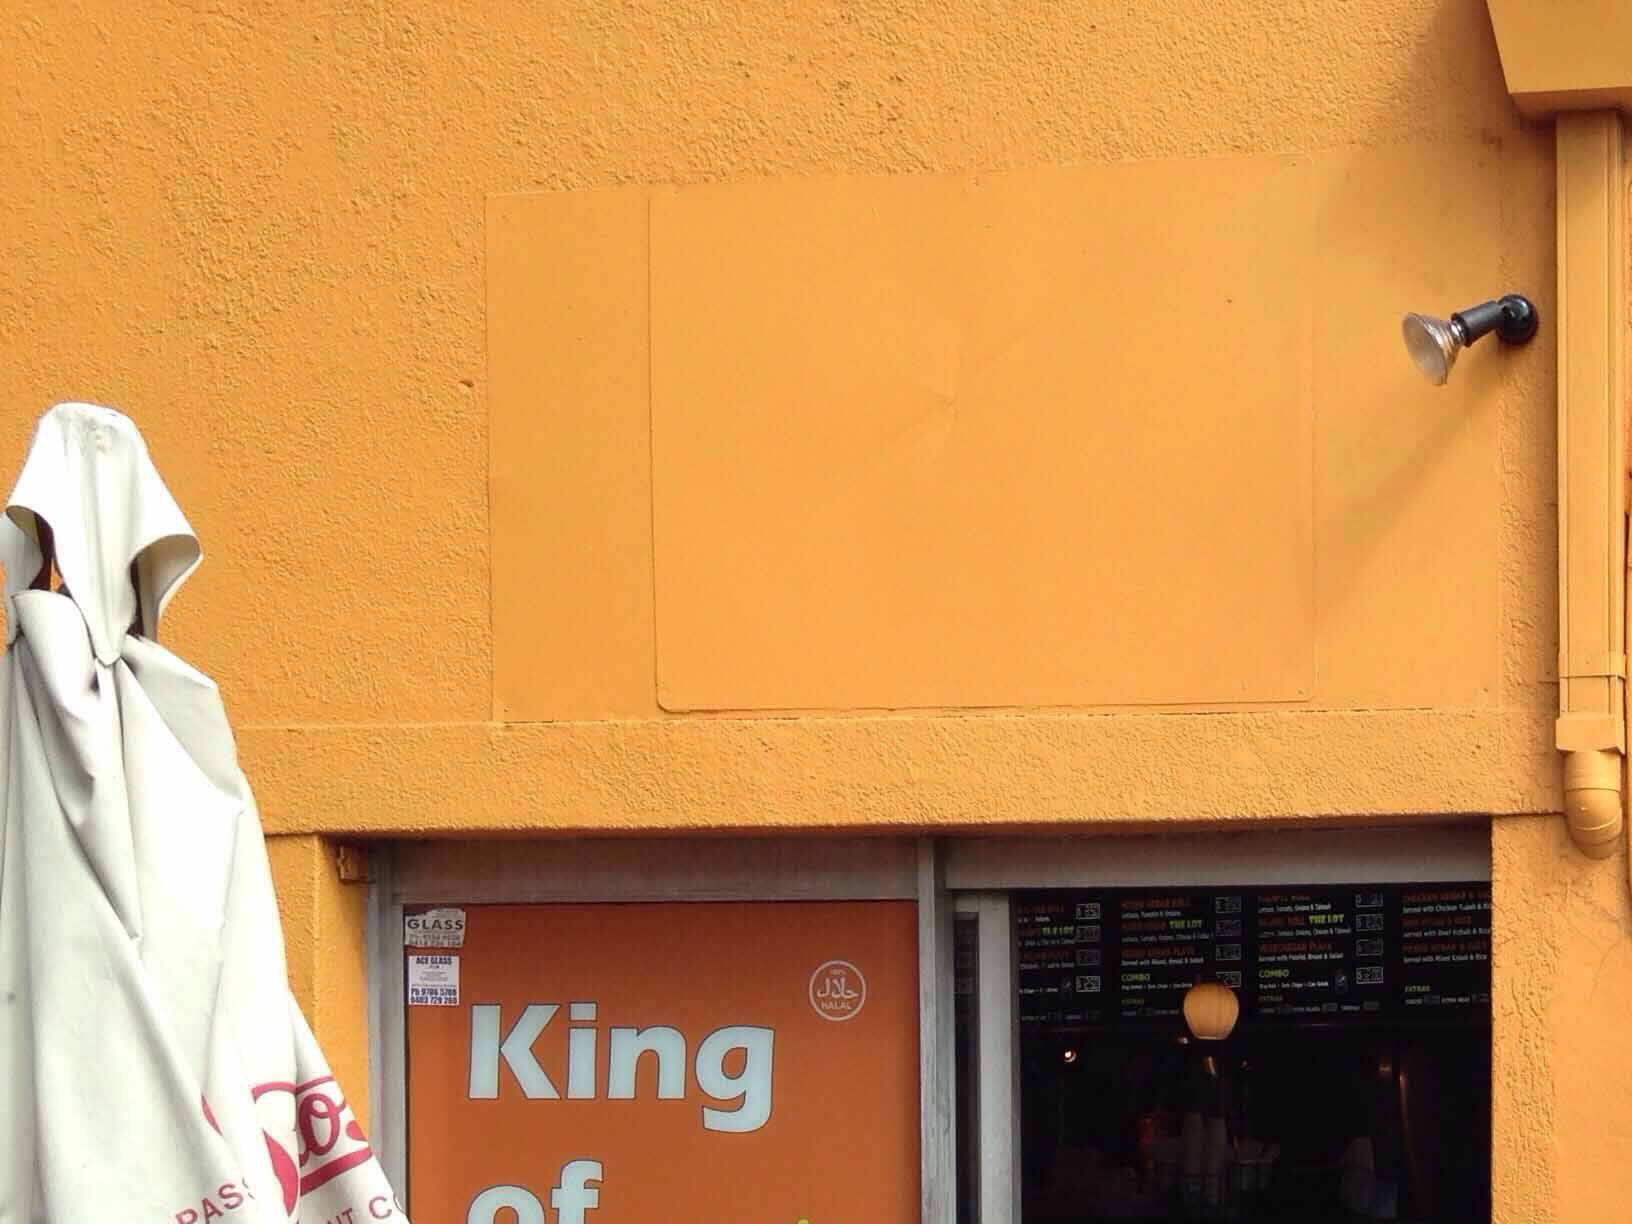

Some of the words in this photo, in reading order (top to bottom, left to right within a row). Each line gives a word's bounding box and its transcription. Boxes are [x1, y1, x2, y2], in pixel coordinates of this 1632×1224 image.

[407, 917, 465, 931] GLASS
[820, 1000, 853, 1011] HALAL
[467, 1002, 776, 1133] King
